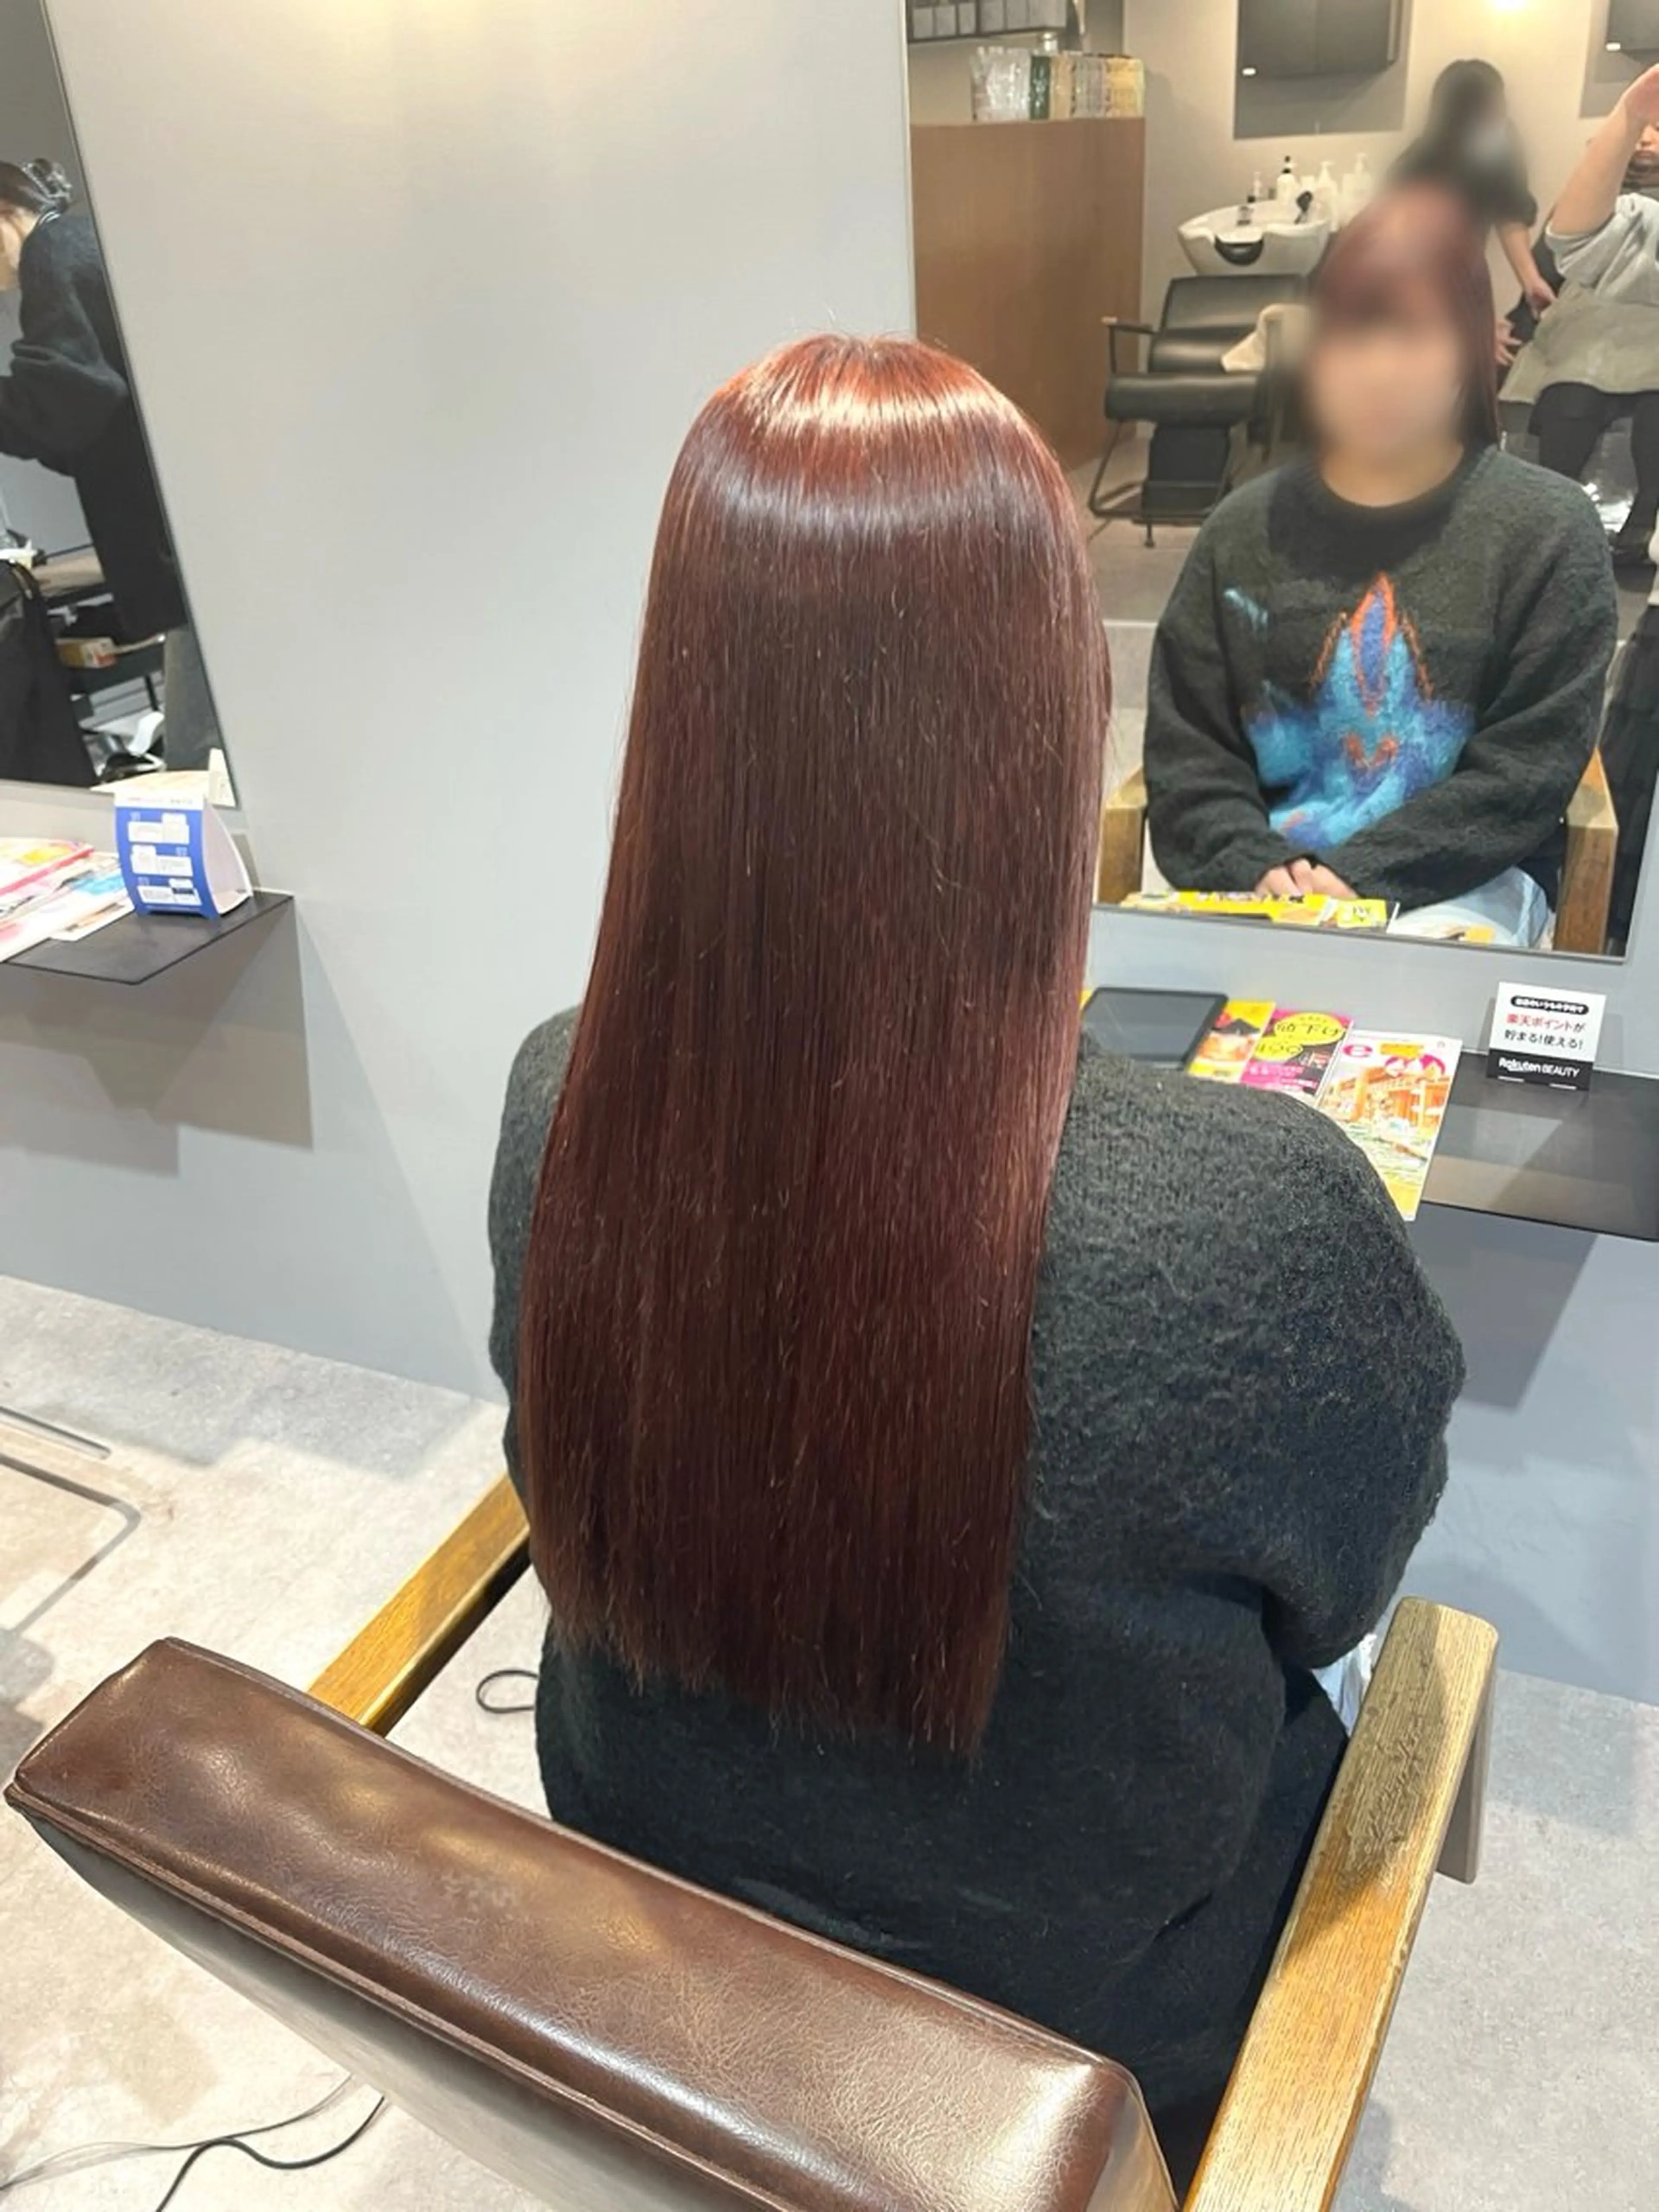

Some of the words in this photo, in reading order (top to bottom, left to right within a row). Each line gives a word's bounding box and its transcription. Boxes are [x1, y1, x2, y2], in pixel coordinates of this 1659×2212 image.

[1506, 1013, 1586, 1034] 楽天ポイントが
[1498, 1057, 1541, 1074] Rakuten
[1542, 1062, 1580, 1077] BEAUTY
